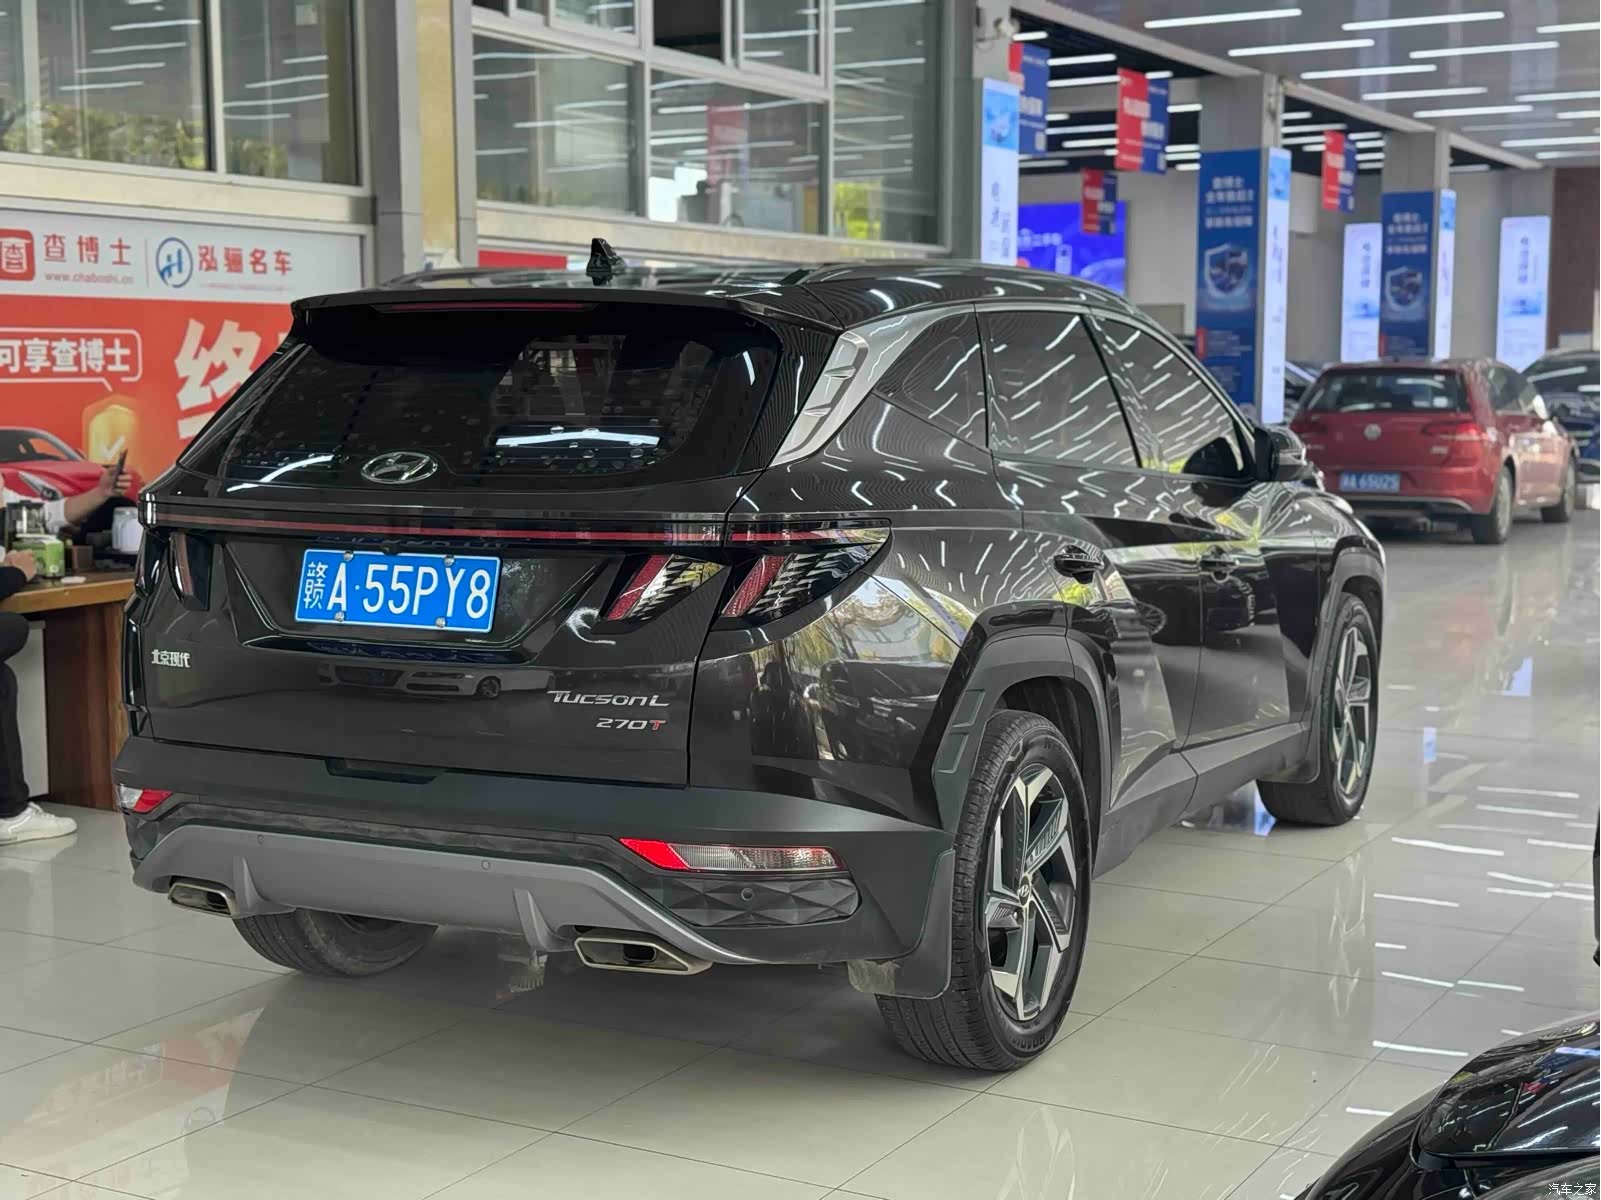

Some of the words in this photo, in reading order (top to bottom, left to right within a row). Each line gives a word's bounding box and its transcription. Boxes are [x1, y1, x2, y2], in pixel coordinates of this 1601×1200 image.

[43, 233, 131, 265] 查博士
[174, 318, 290, 440] 终
[151, 649, 191, 668] 北京现代
[596, 717, 667, 731] 270T
